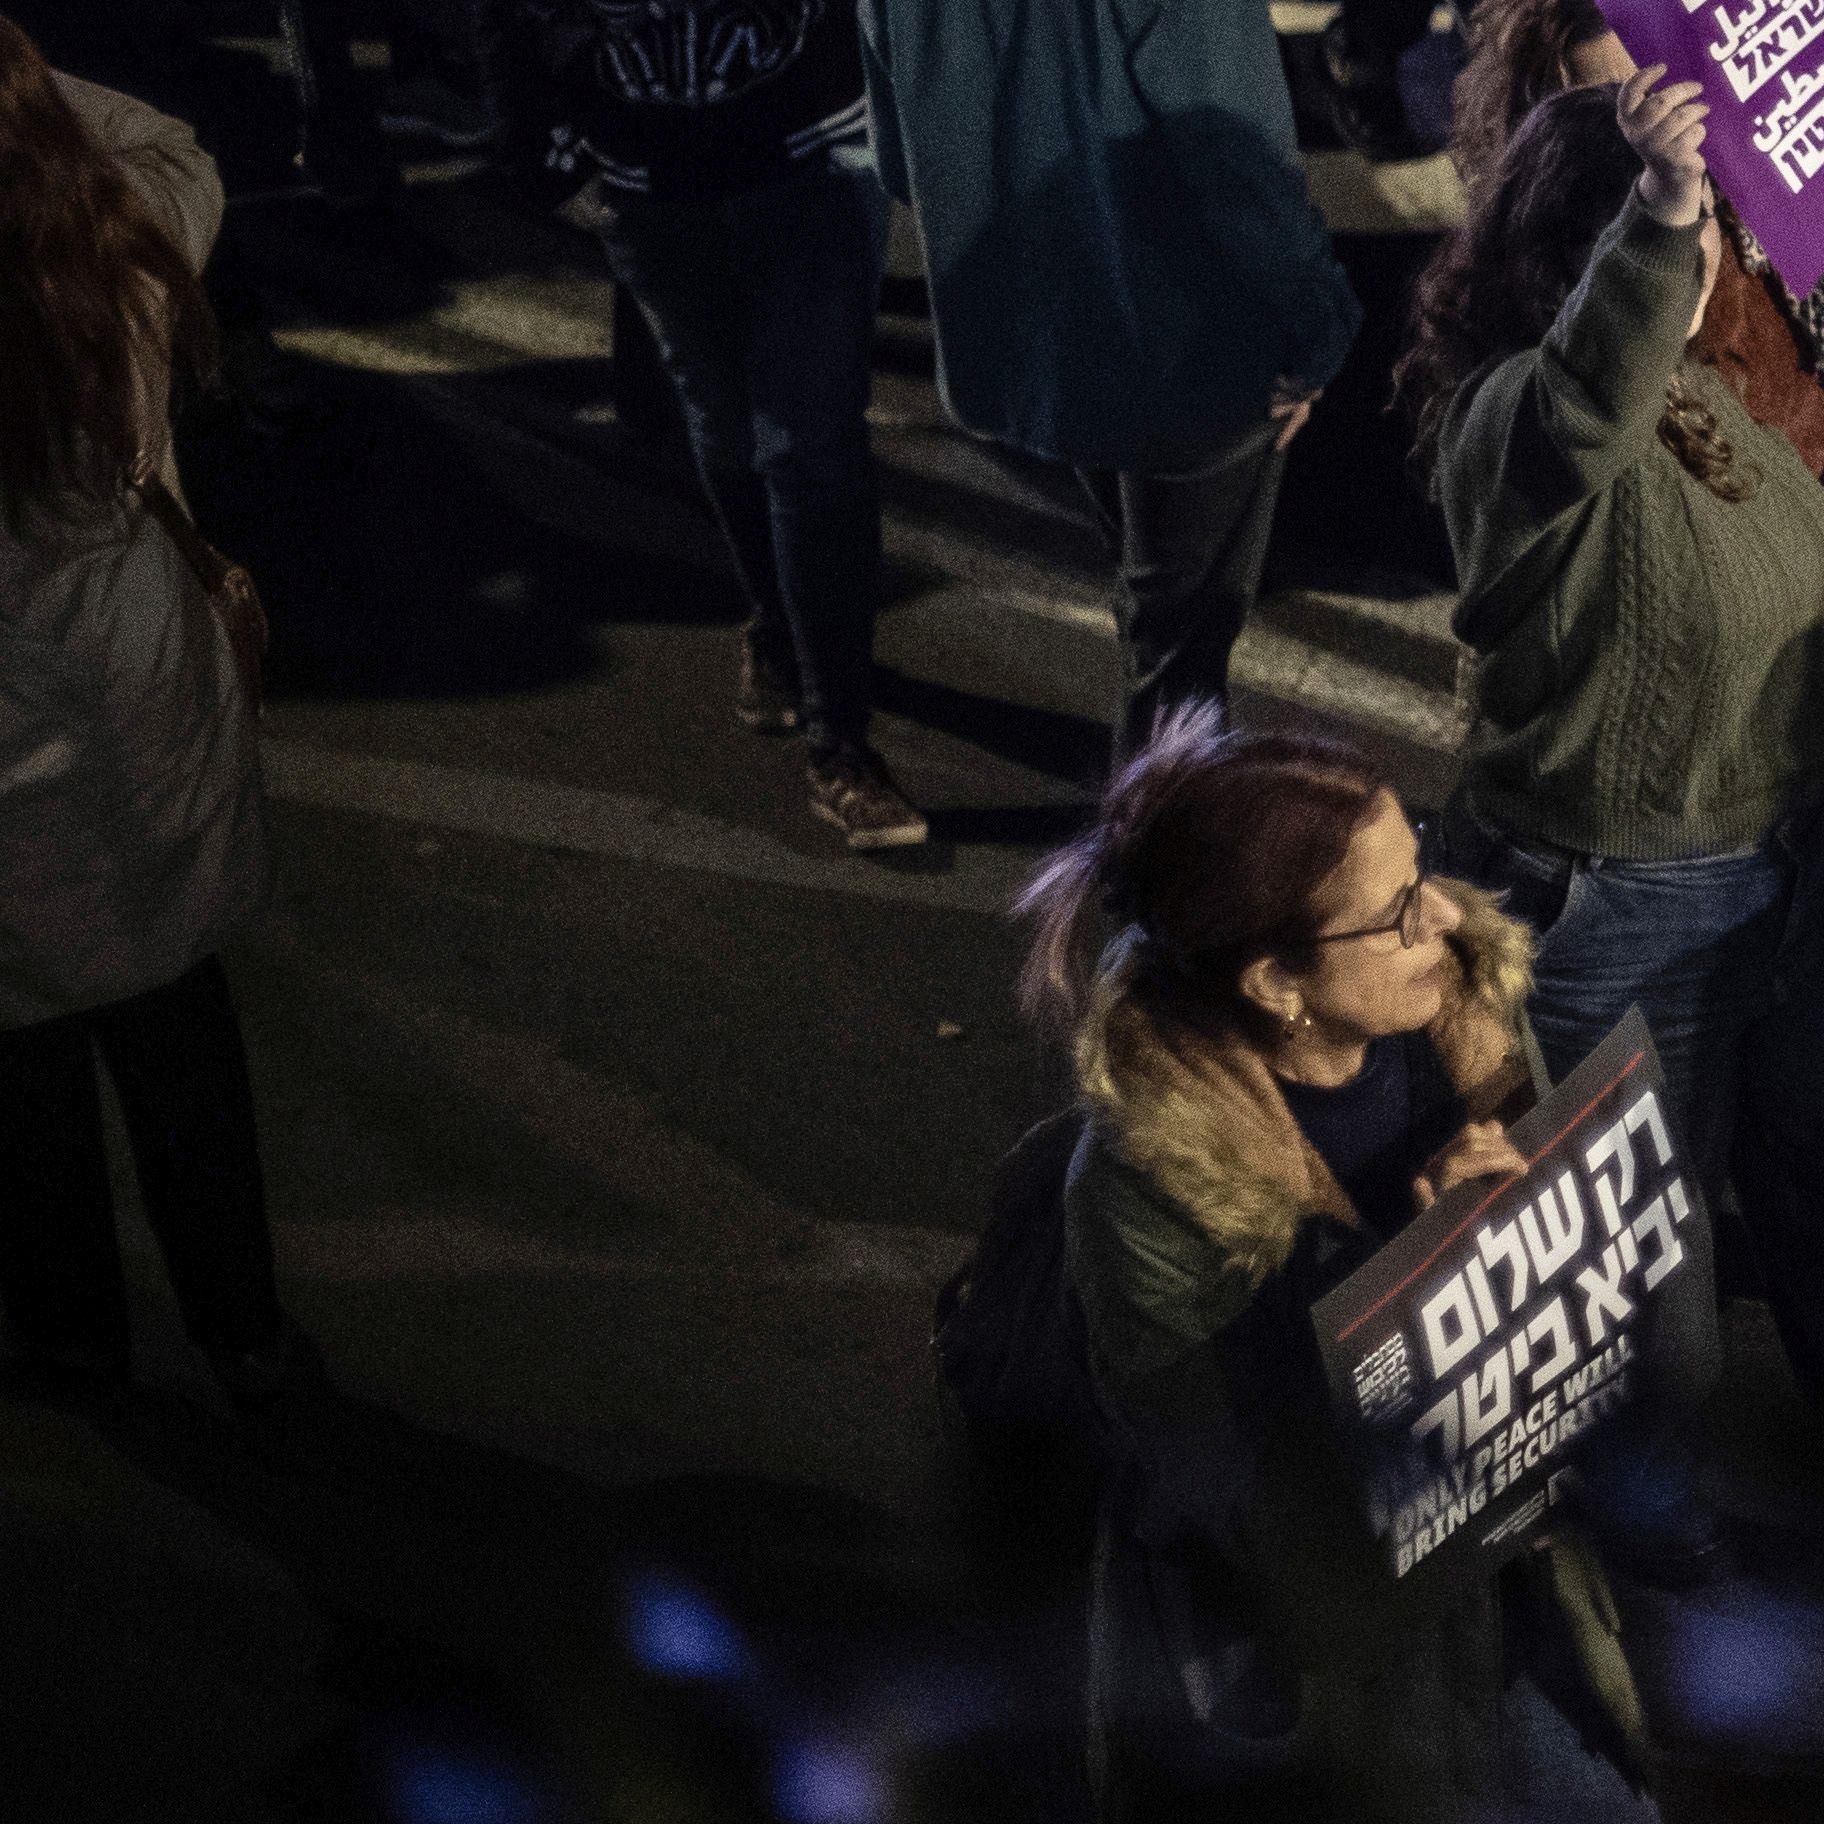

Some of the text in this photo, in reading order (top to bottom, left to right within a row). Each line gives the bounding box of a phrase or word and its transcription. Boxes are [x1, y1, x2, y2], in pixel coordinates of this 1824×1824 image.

[1420, 1087, 1675, 1381] רק שלום
[1574, 1176, 1691, 1348] יביא
[1393, 1479, 1488, 1580] BRING
[1490, 1369, 1630, 1499] SECURITY
[1473, 1389, 1559, 1478] PEACE
[1562, 1332, 1636, 1407] WILL
